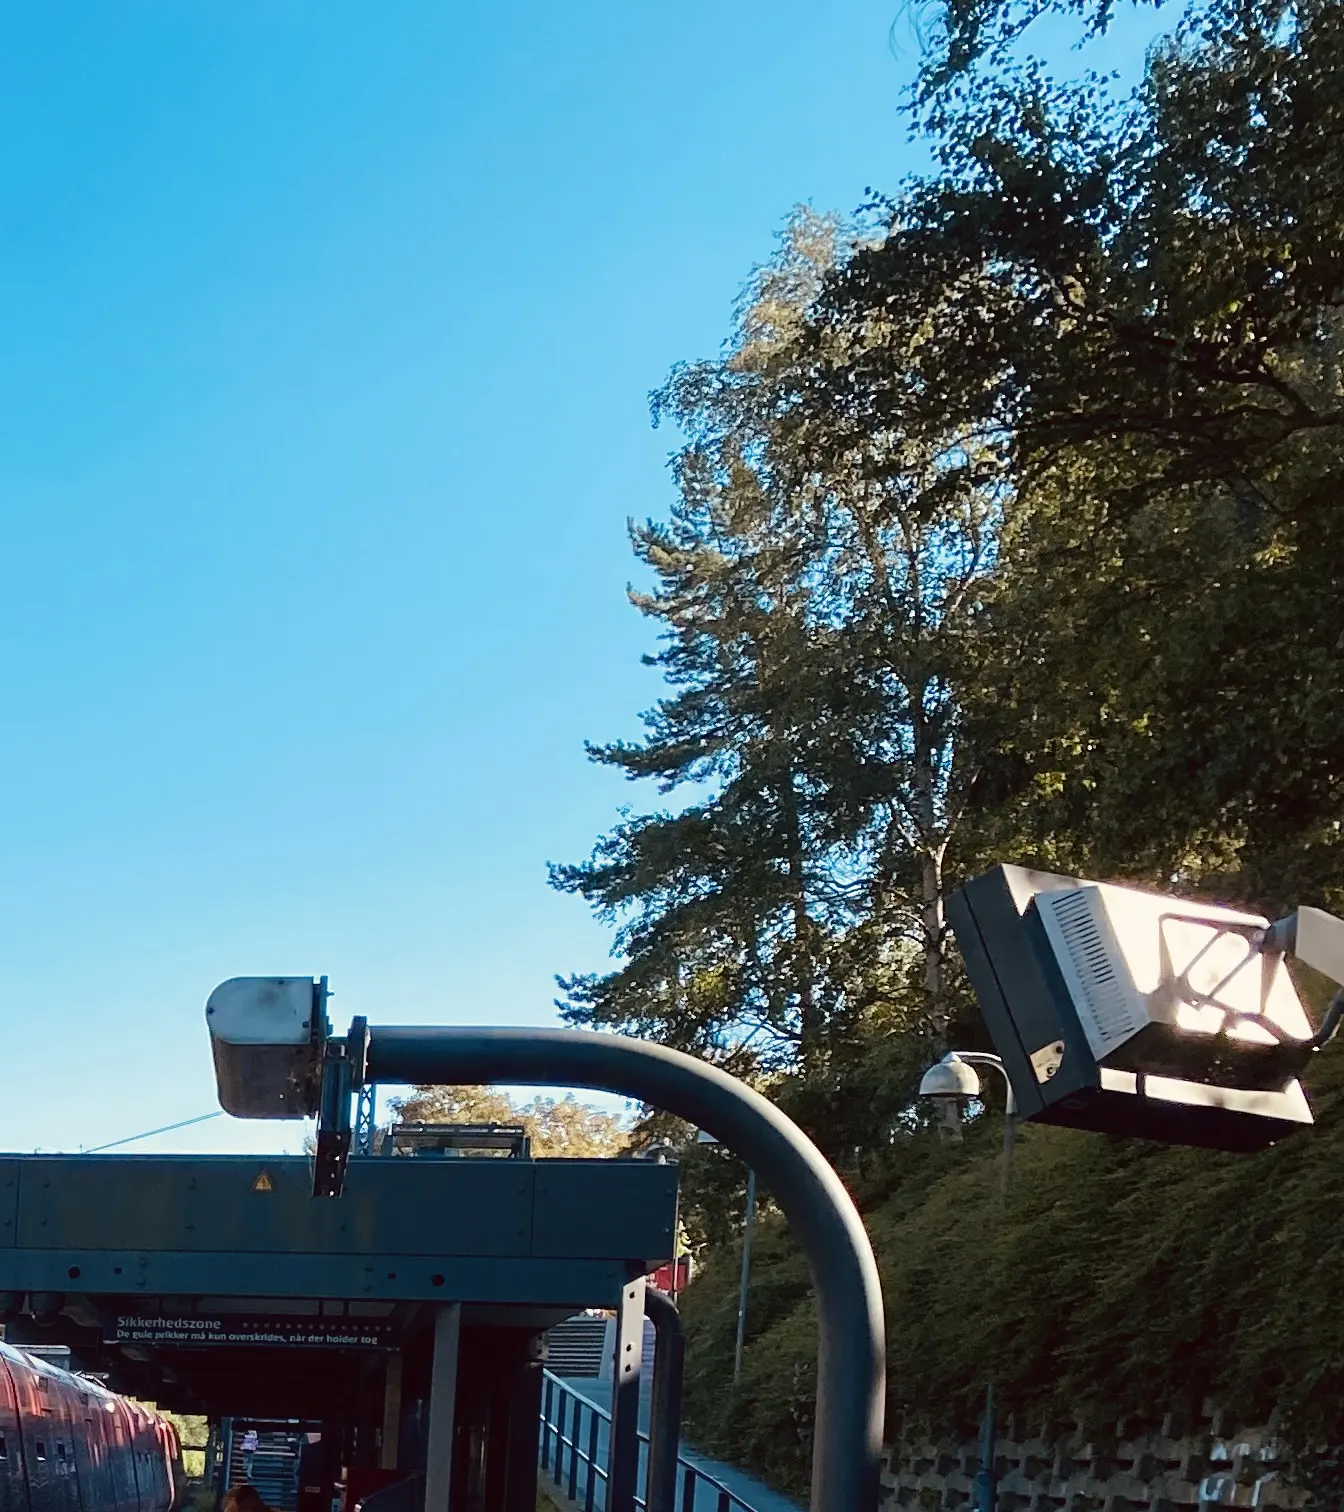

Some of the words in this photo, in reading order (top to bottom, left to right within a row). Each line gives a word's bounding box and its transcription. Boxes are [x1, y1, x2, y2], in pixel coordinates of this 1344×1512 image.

[116, 1316, 222, 1330] Sikkerhedszone
[116, 1329, 130, 1339] De
[132, 1330, 153, 1340] gule
[155, 1331, 189, 1341] prikker
[191, 1330, 206, 1340] må
[208, 1332, 227, 1341] kun
[228, 1332, 287, 1343] overskrides,
[289, 1333, 305, 1343] når
[308, 1333, 324, 1343] der
[326, 1334, 359, 1344] holder
[360, 1335, 378, 1345] tog
